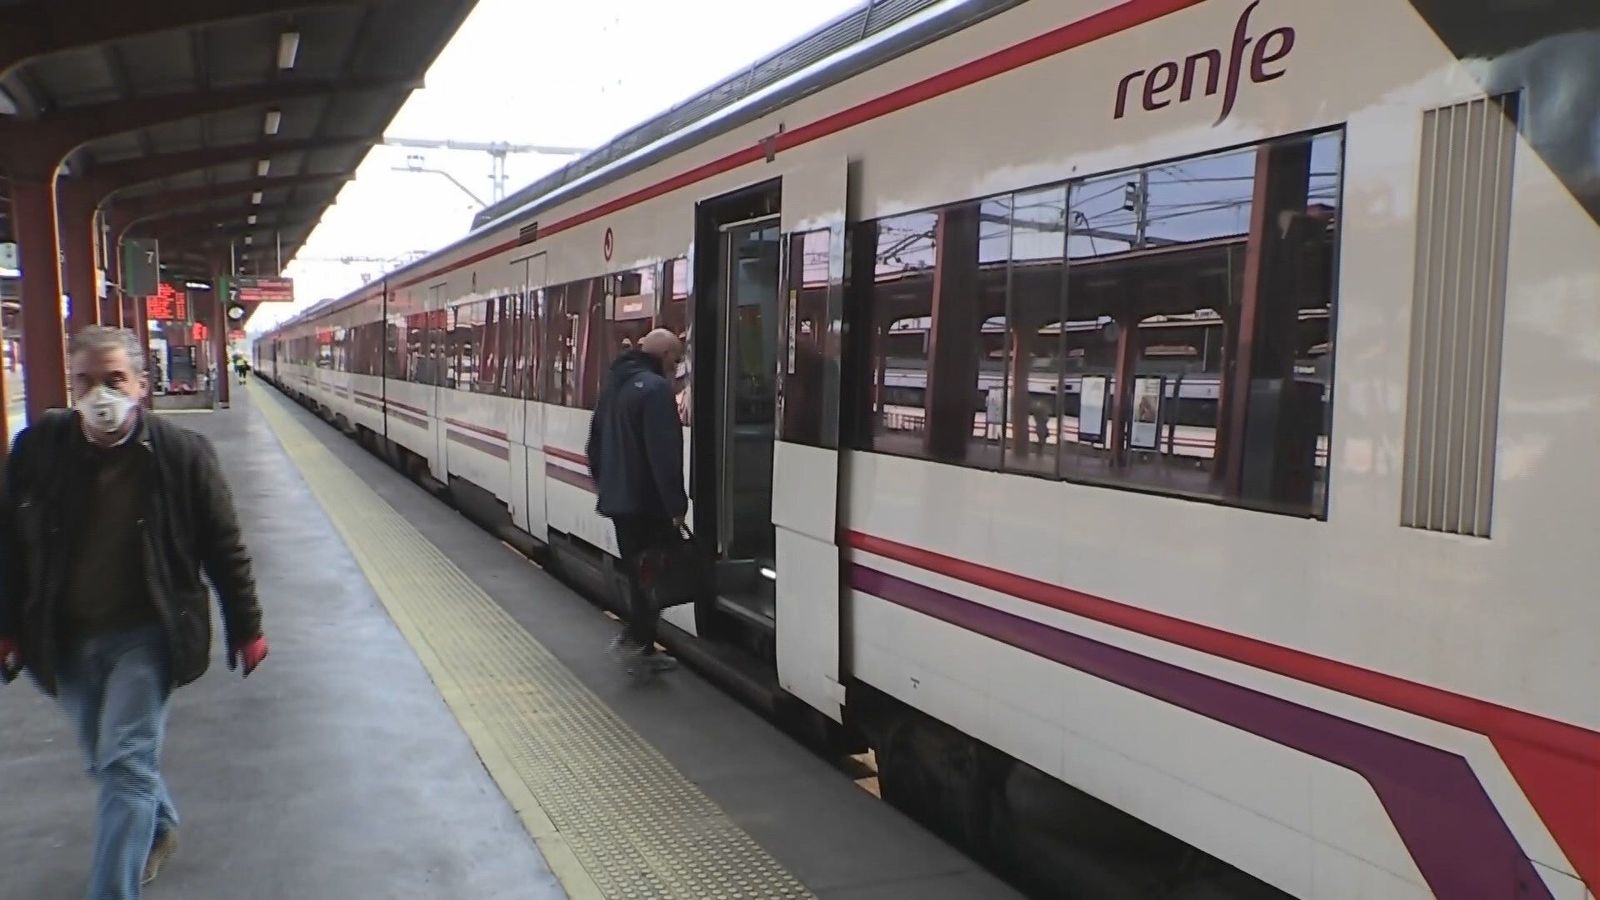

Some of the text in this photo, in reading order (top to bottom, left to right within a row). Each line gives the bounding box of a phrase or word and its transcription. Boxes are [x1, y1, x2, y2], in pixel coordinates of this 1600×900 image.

[1113, 0, 1295, 128] renfe
[145, 251, 154, 263] 7
[229, 290, 237, 301] 7
